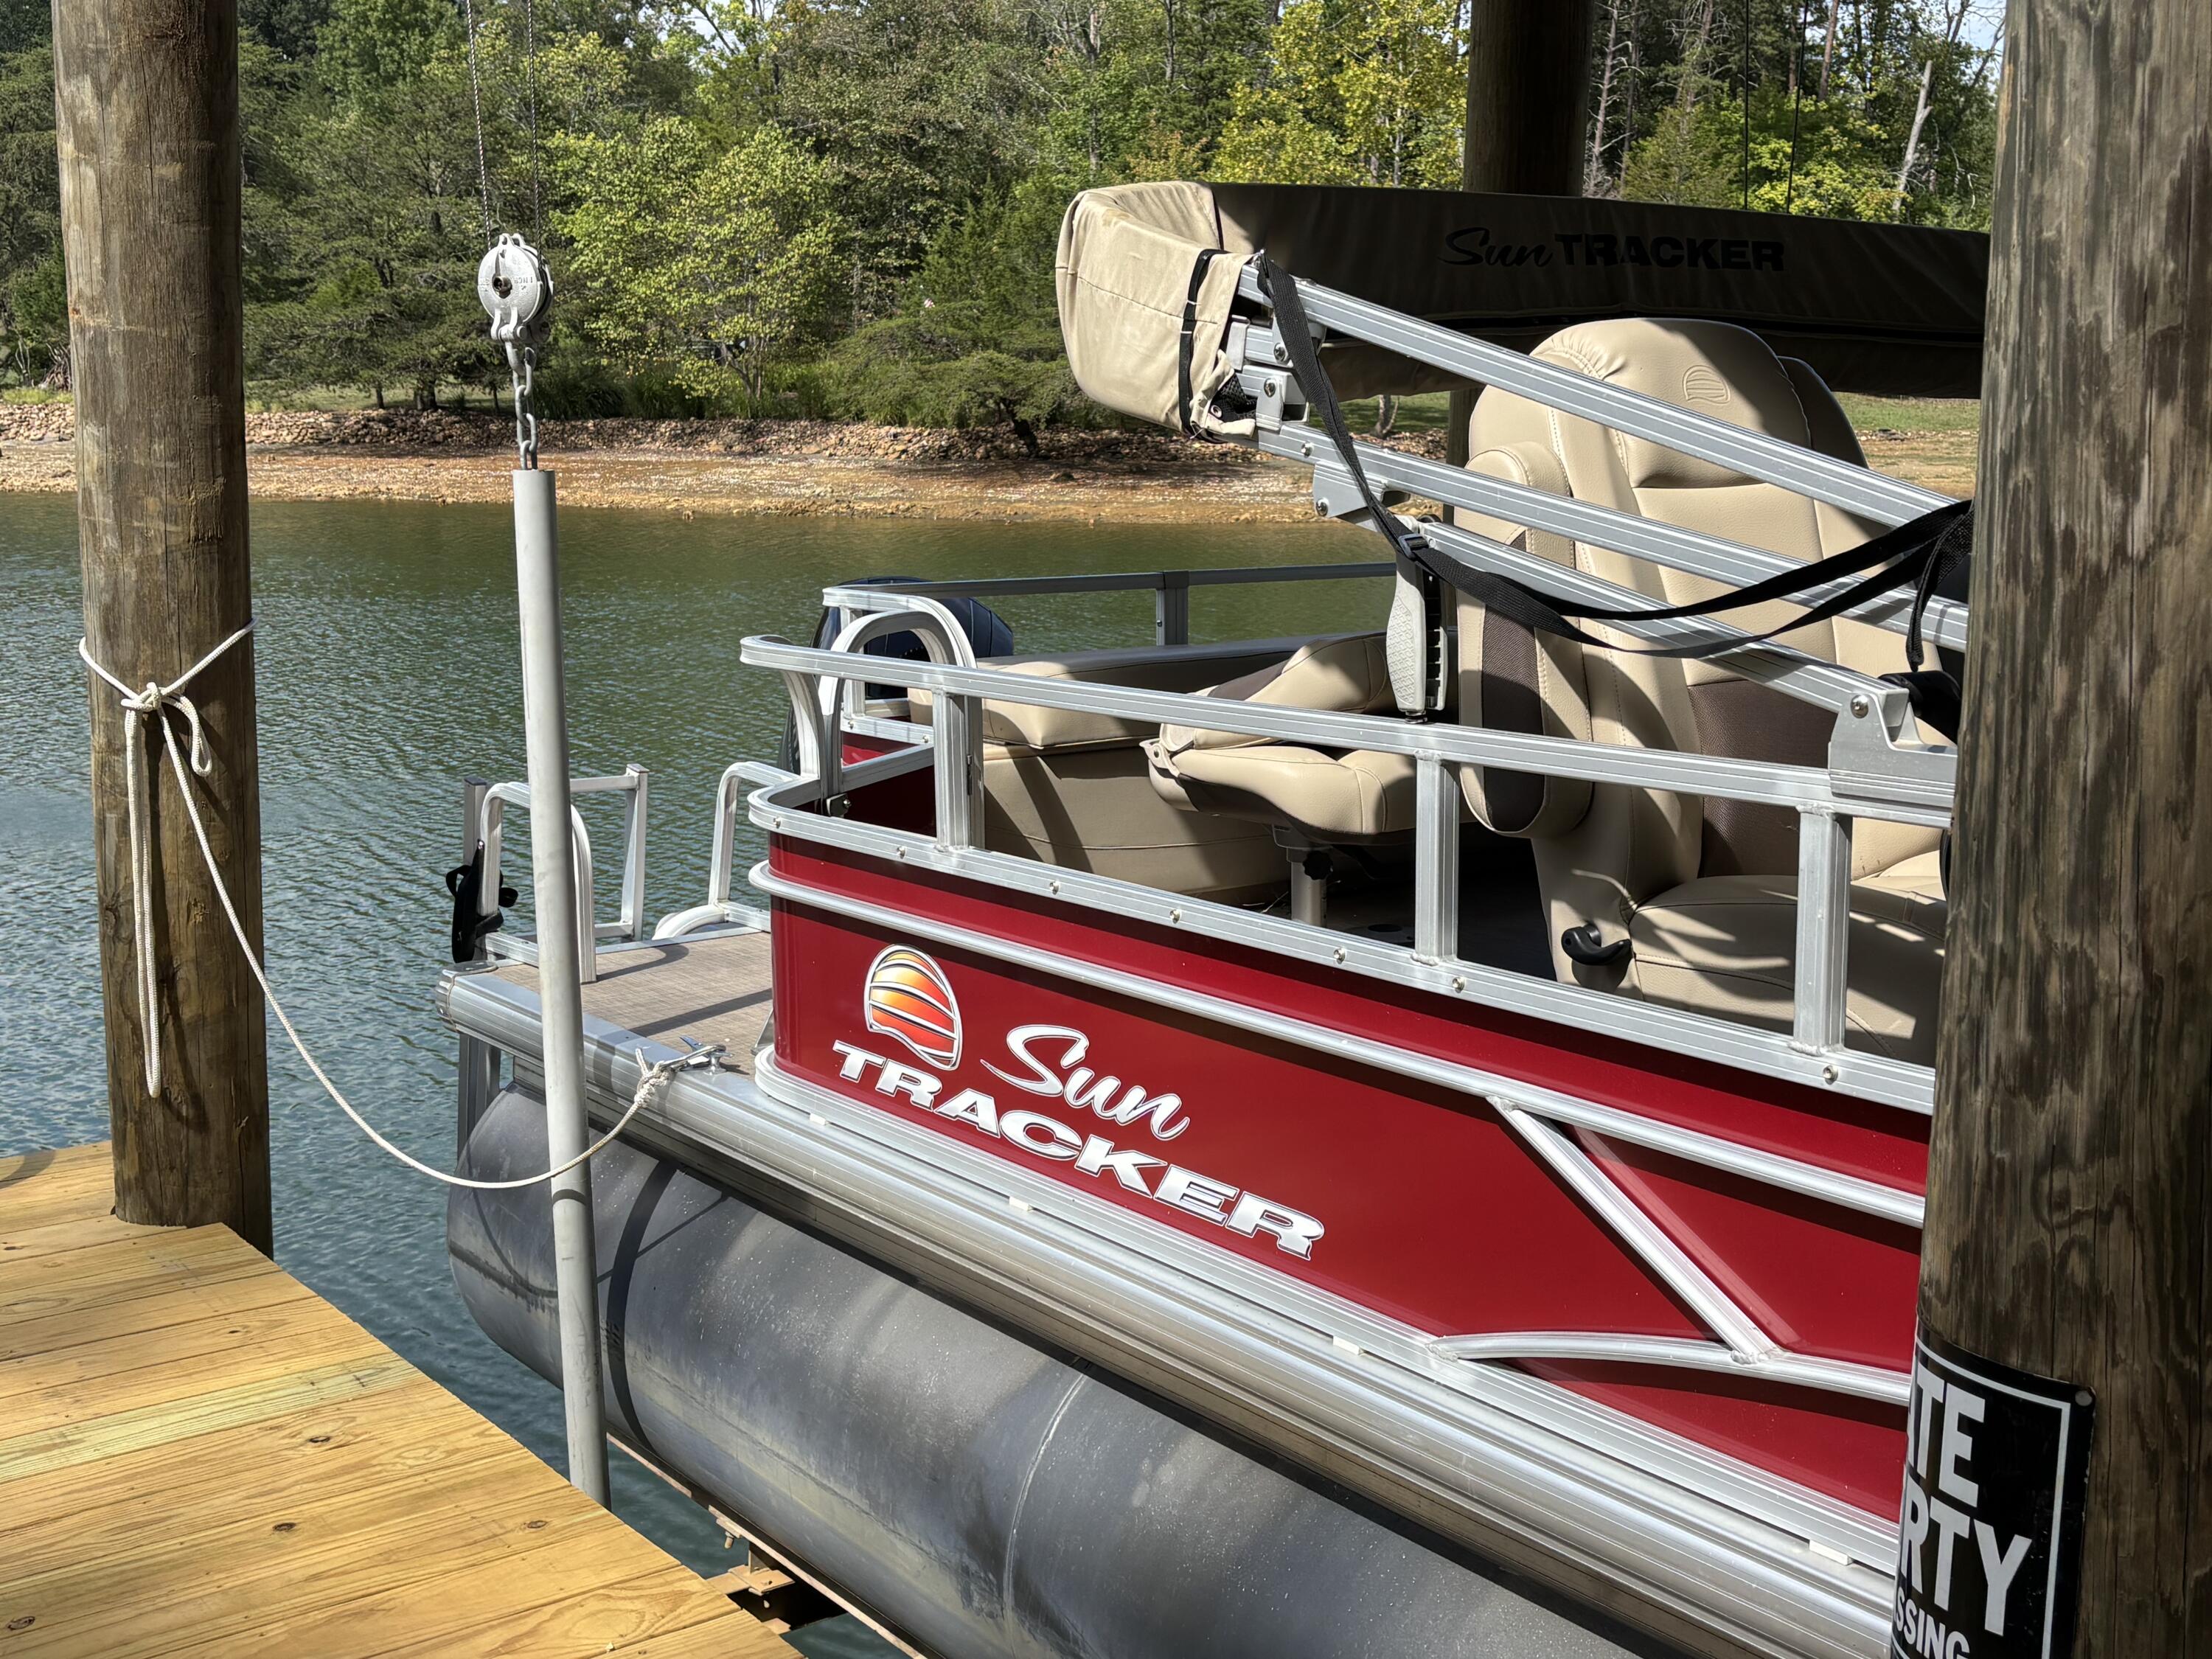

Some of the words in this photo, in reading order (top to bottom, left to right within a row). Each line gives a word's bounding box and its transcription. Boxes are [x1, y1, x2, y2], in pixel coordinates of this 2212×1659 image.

[1438, 227, 1553, 267] Sun
[1554, 232, 1785, 271] TRACKER
[980, 1023, 1191, 1141] Sun
[832, 1040, 1325, 1261] TRACKER
